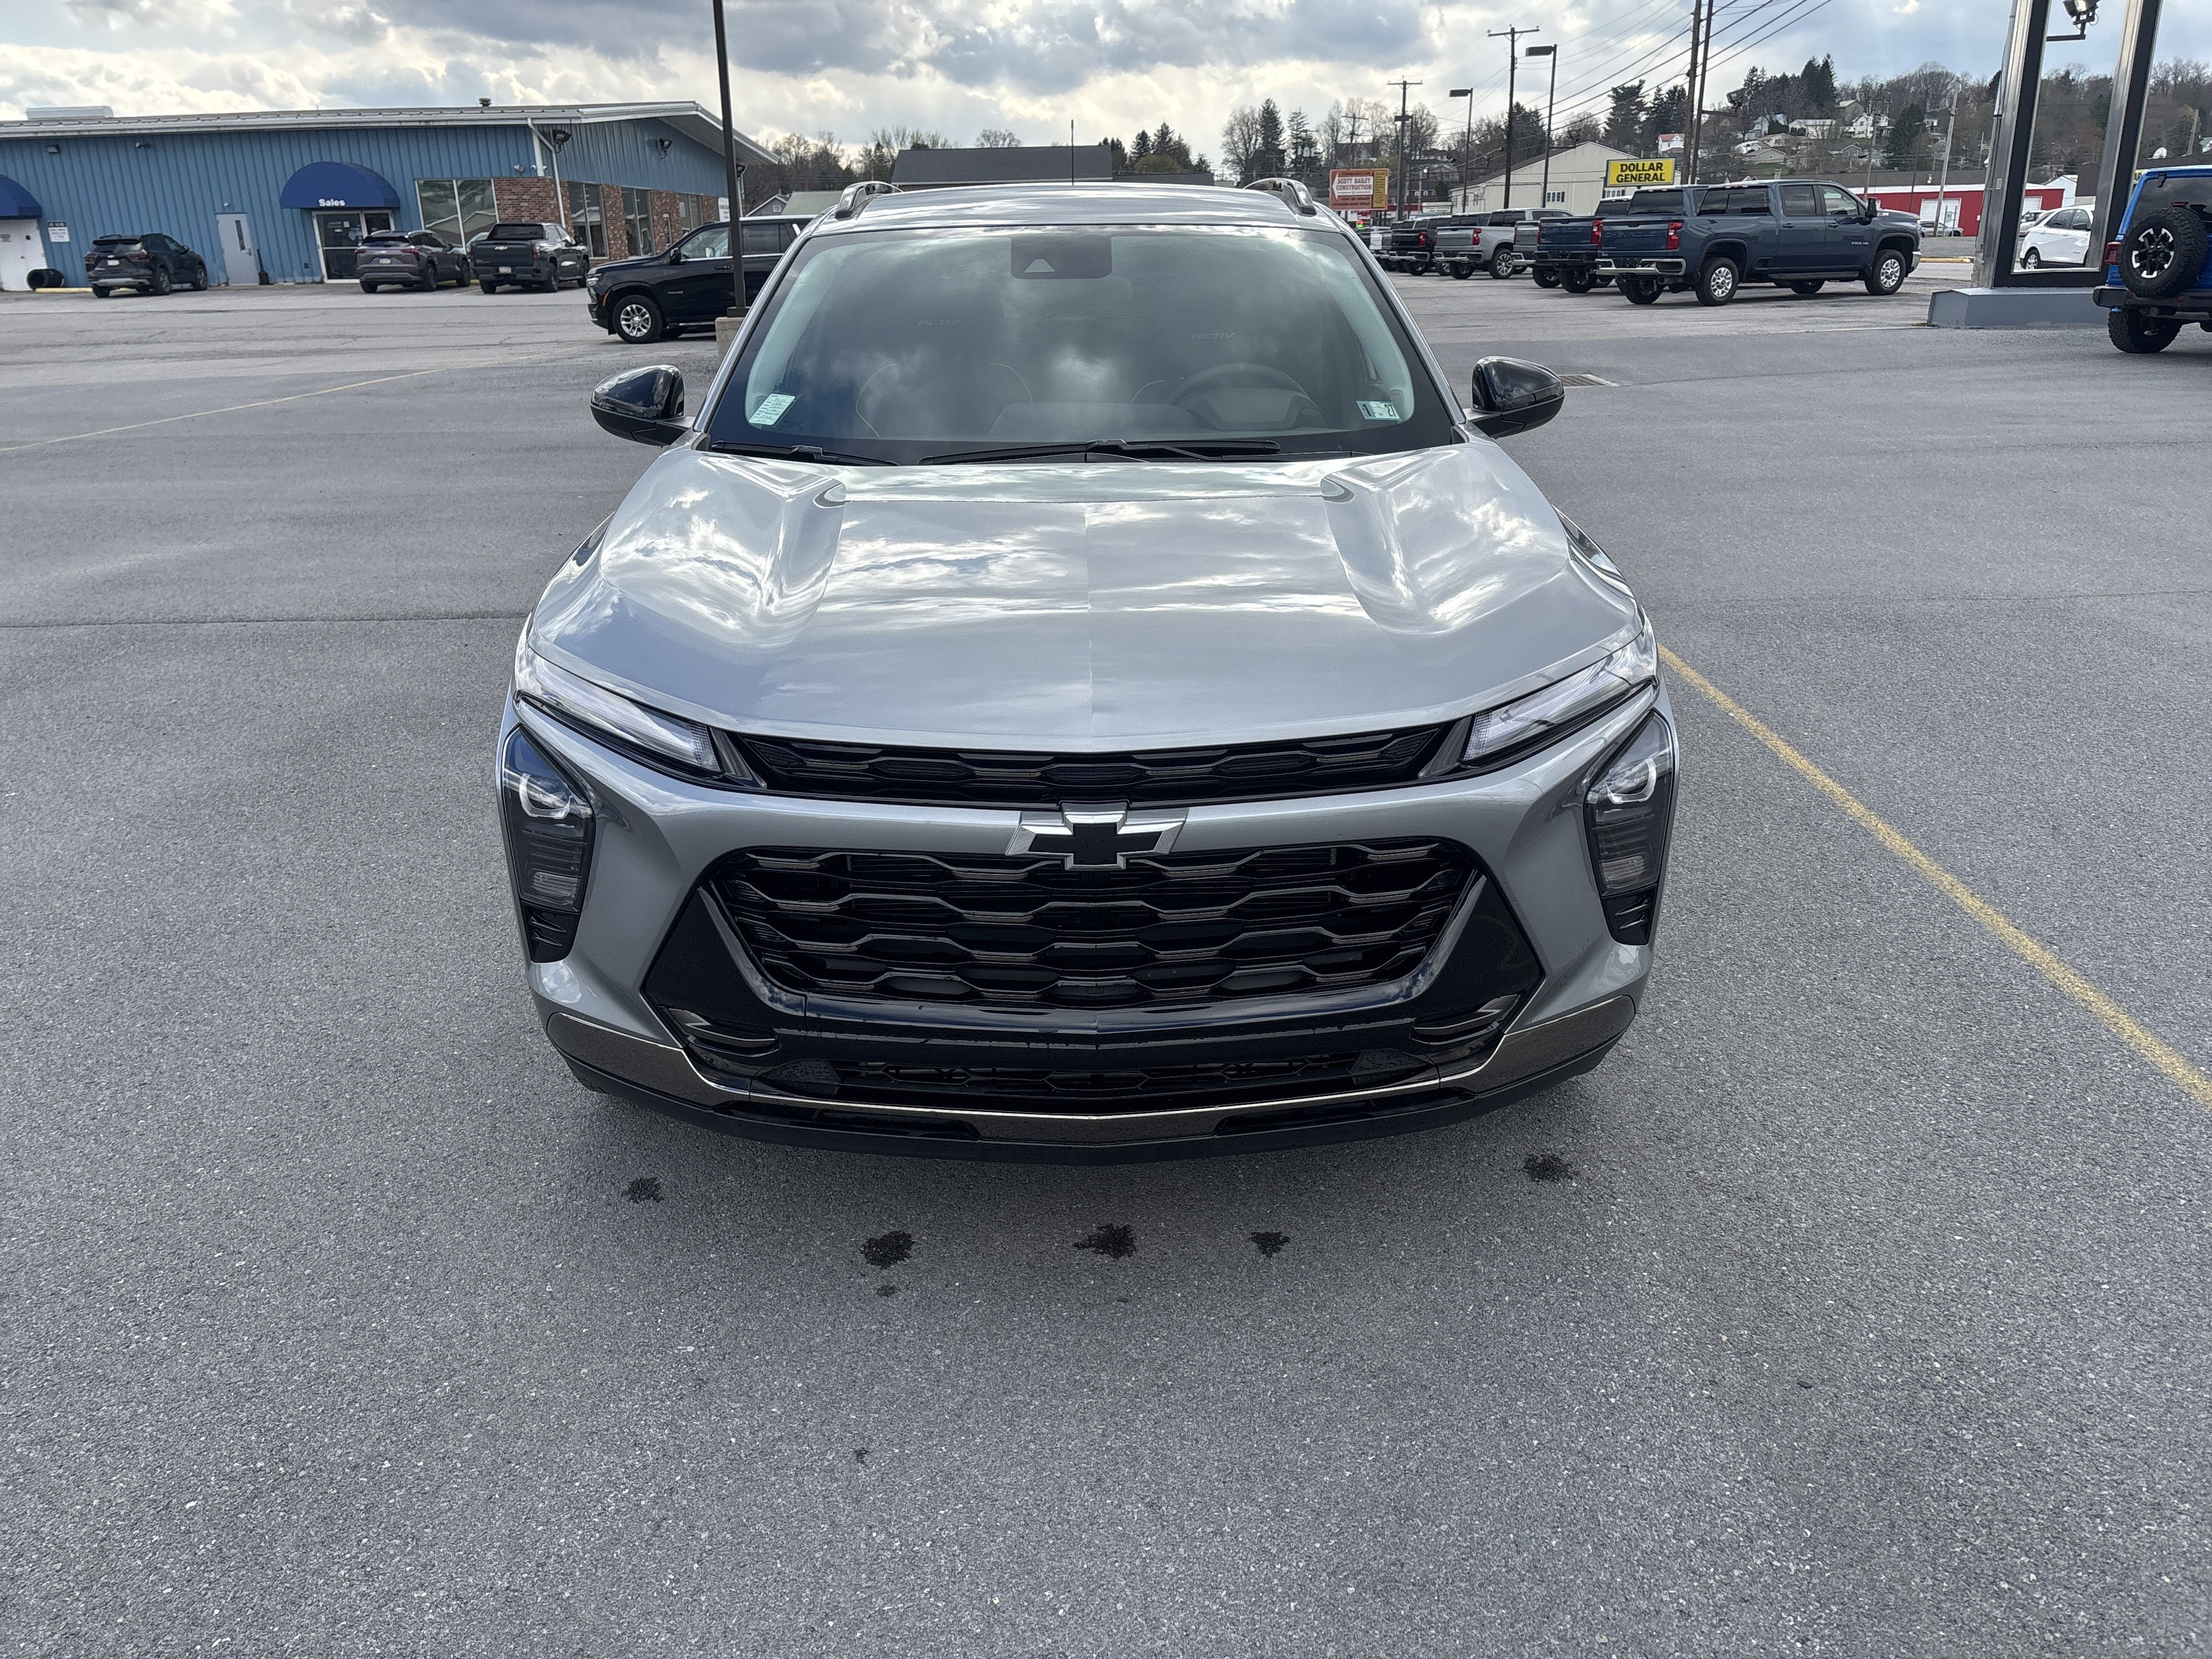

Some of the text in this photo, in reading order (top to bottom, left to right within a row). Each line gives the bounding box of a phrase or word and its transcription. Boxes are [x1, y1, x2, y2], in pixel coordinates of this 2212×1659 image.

[1620, 162, 1663, 172] DOLLAR
[1616, 173, 1666, 183] GENERAL
[318, 198, 346, 207] Sales
